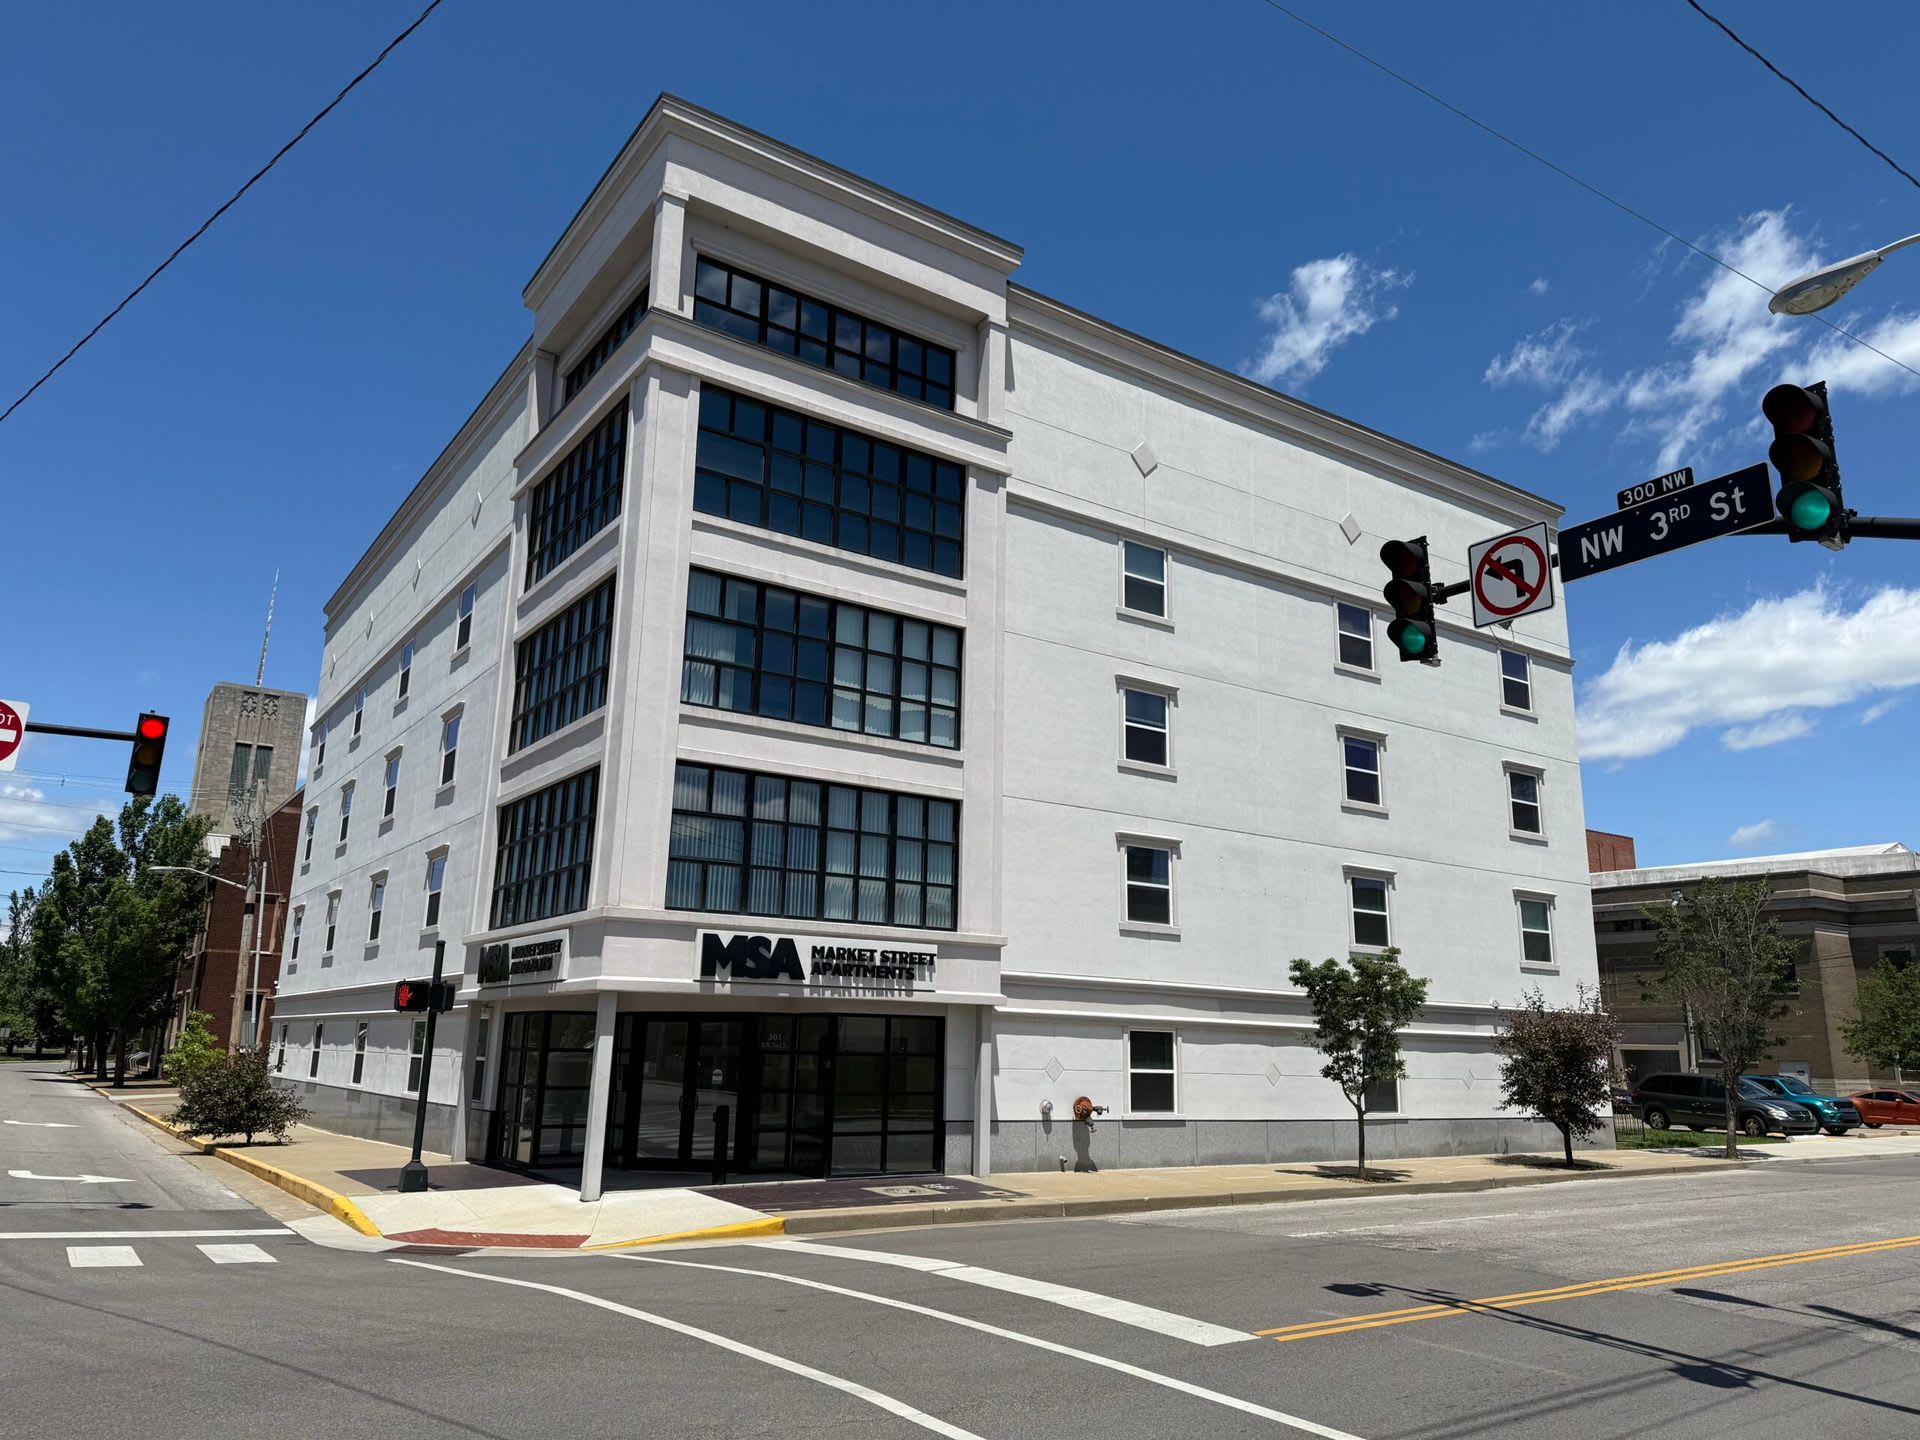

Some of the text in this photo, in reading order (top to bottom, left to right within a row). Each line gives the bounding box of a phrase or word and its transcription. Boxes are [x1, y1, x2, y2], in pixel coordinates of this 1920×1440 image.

[1623, 470, 1687, 505] 300 NW
[1580, 486, 1746, 564] NW 3RD St
[701, 933, 805, 980] MSA
[811, 945, 937, 966] MARKET STREET
[811, 962, 915, 980] APARTMENTS
[768, 1033, 782, 1041] 301
